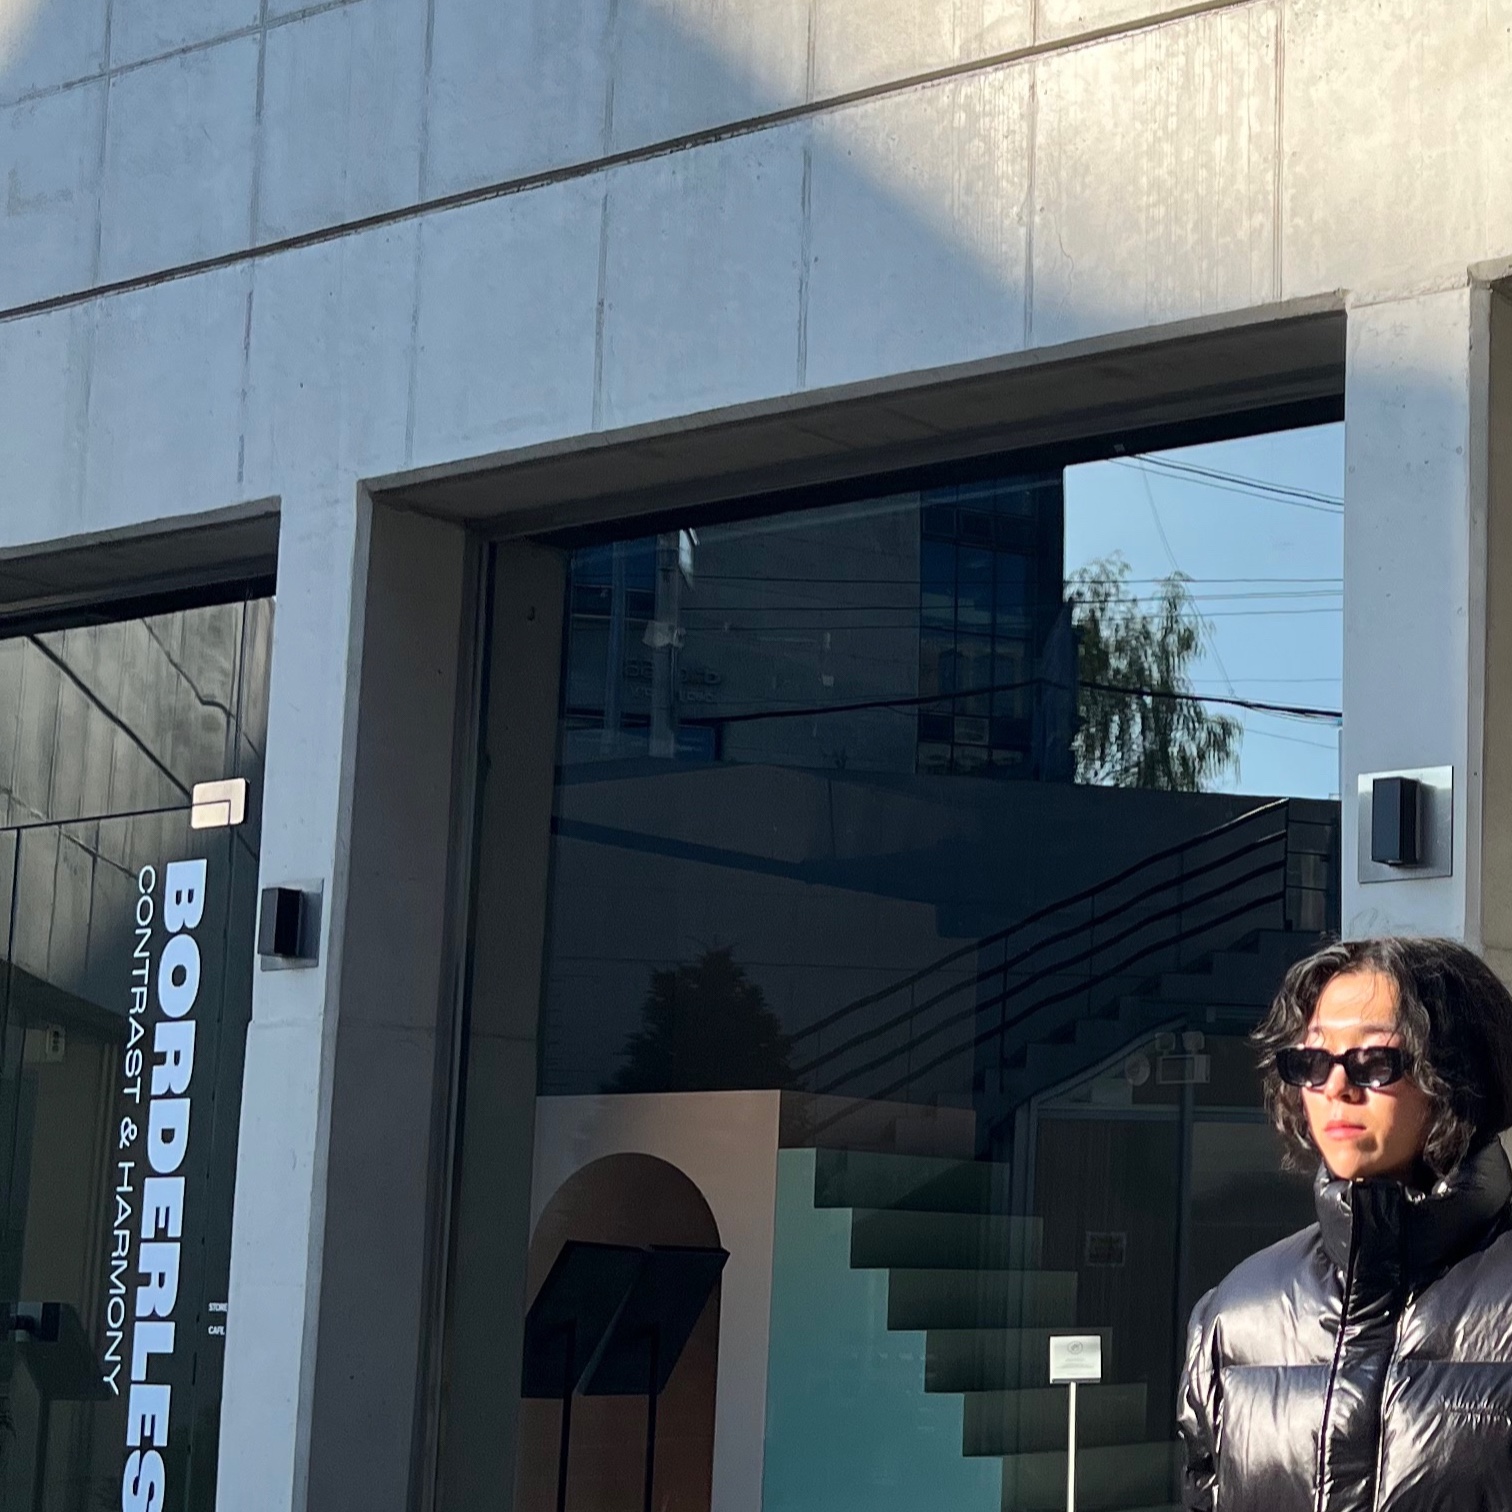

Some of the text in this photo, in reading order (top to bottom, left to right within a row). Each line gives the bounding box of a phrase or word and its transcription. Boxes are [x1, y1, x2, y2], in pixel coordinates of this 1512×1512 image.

[102, 864, 156, 1396] CONTRAST & HARMONY
